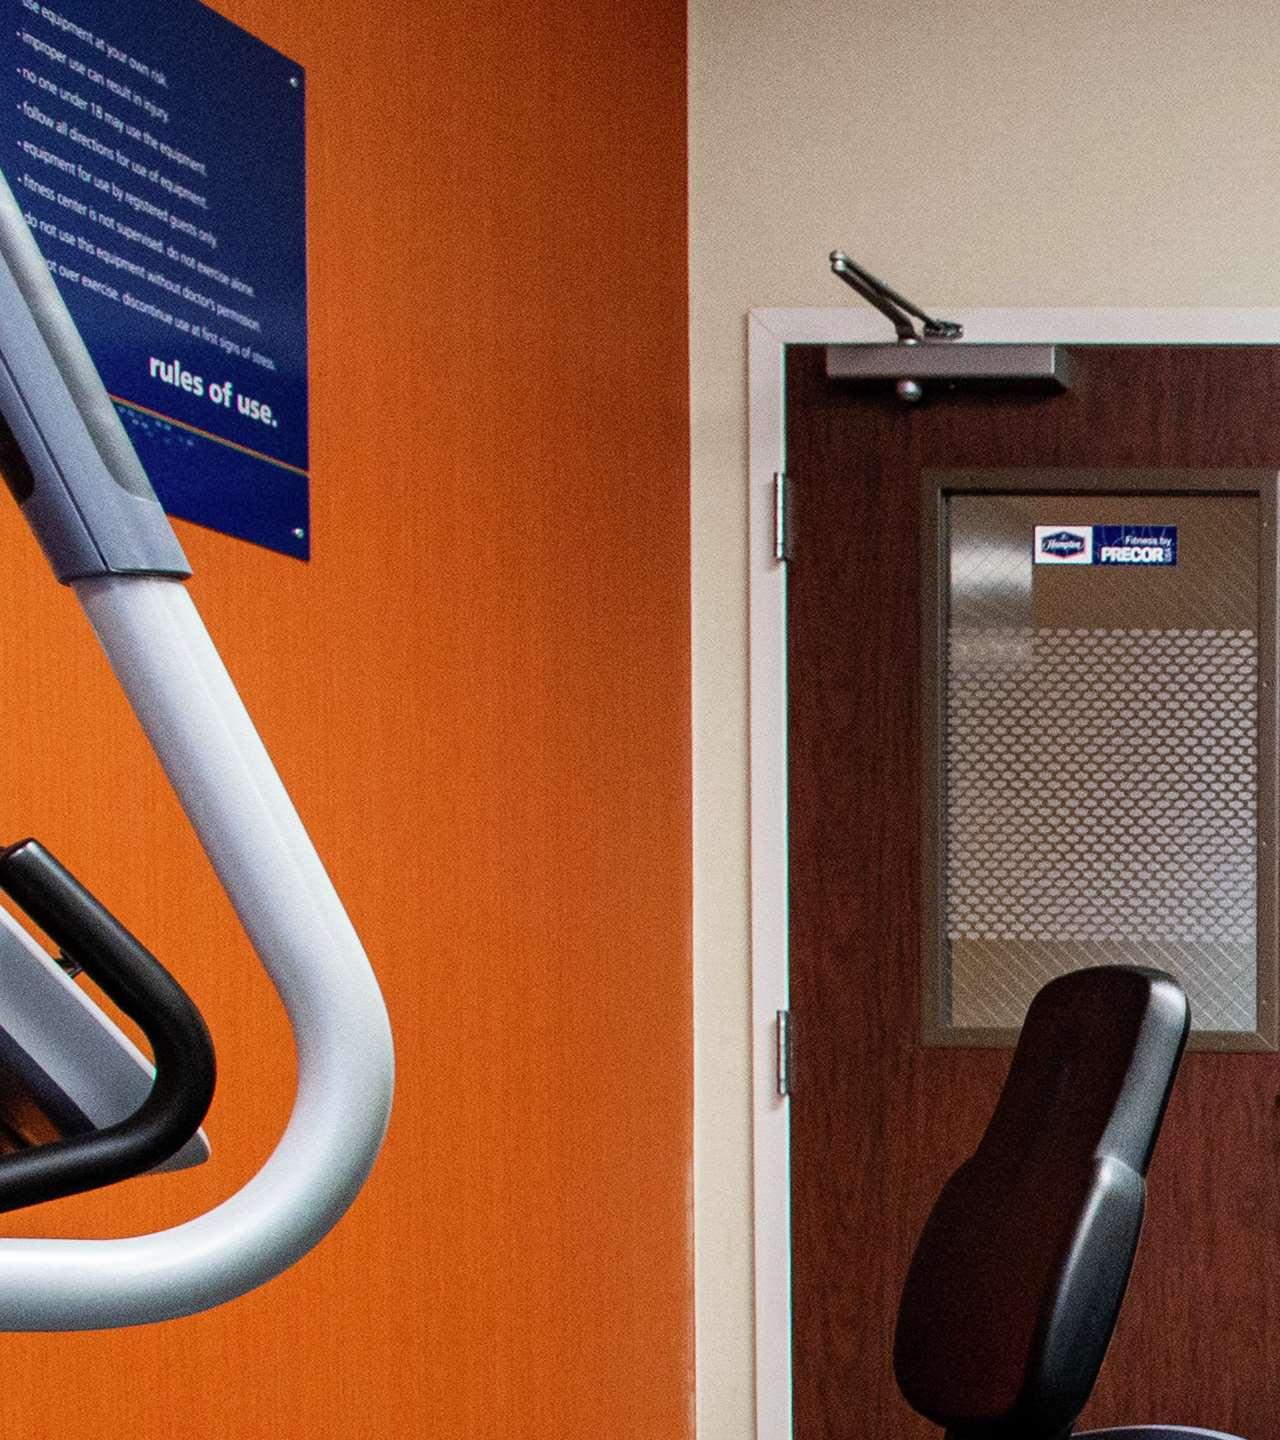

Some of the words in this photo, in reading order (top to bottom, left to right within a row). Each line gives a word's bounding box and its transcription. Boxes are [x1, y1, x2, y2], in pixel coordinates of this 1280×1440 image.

[22, 27, 68, 64] improper
[69, 58, 86, 76] use
[87, 68, 105, 87] can
[106, 78, 132, 101] result
[132, 92, 143, 106] in
[41, 6, 94, 46] equipment
[106, 44, 128, 64] your
[129, 57, 149, 78] own
[22, 68, 37, 84] no
[38, 77, 58, 95] one
[59, 88, 88, 111] under
[91, 102, 103, 119] 18
[104, 112, 124, 134] may
[125, 124, 142, 140] use
[143, 131, 158, 150] the
[23, 101, 54, 128] follow
[56, 120, 68, 136] all
[69, 127, 114, 160] directions
[116, 147, 130, 169] for
[131, 162, 147, 178] use
[148, 169, 160, 183] of
[23, 140, 76, 177] equipment
[78, 163, 91, 184] for
[93, 176, 110, 193] use
[112, 182, 124, 202] by
[124, 192, 168, 222] registered
[169, 215, 198, 237] guests
[23, 173, 56, 201] fitness
[57, 193, 87, 215] center
[88, 205, 98, 222] is
[98, 213, 115, 230] not
[166, 244, 179, 261] do
[180, 253, 195, 270] not
[197, 261, 230, 285] exercise
[24, 210, 38, 228] do
[39, 220, 57, 238] not
[59, 229, 76, 247] use
[77, 236, 96, 255] this
[97, 247, 146, 280] equipment
[146, 271, 181, 297] without
[59, 264, 80, 282] over
[122, 292, 174, 326] discontinue
[174, 317, 191, 333] use
[149, 356, 204, 398] rules
[208, 381, 233, 408] of
[237, 394, 278, 428] use.
[1101, 546, 1164, 562] PRECOR
